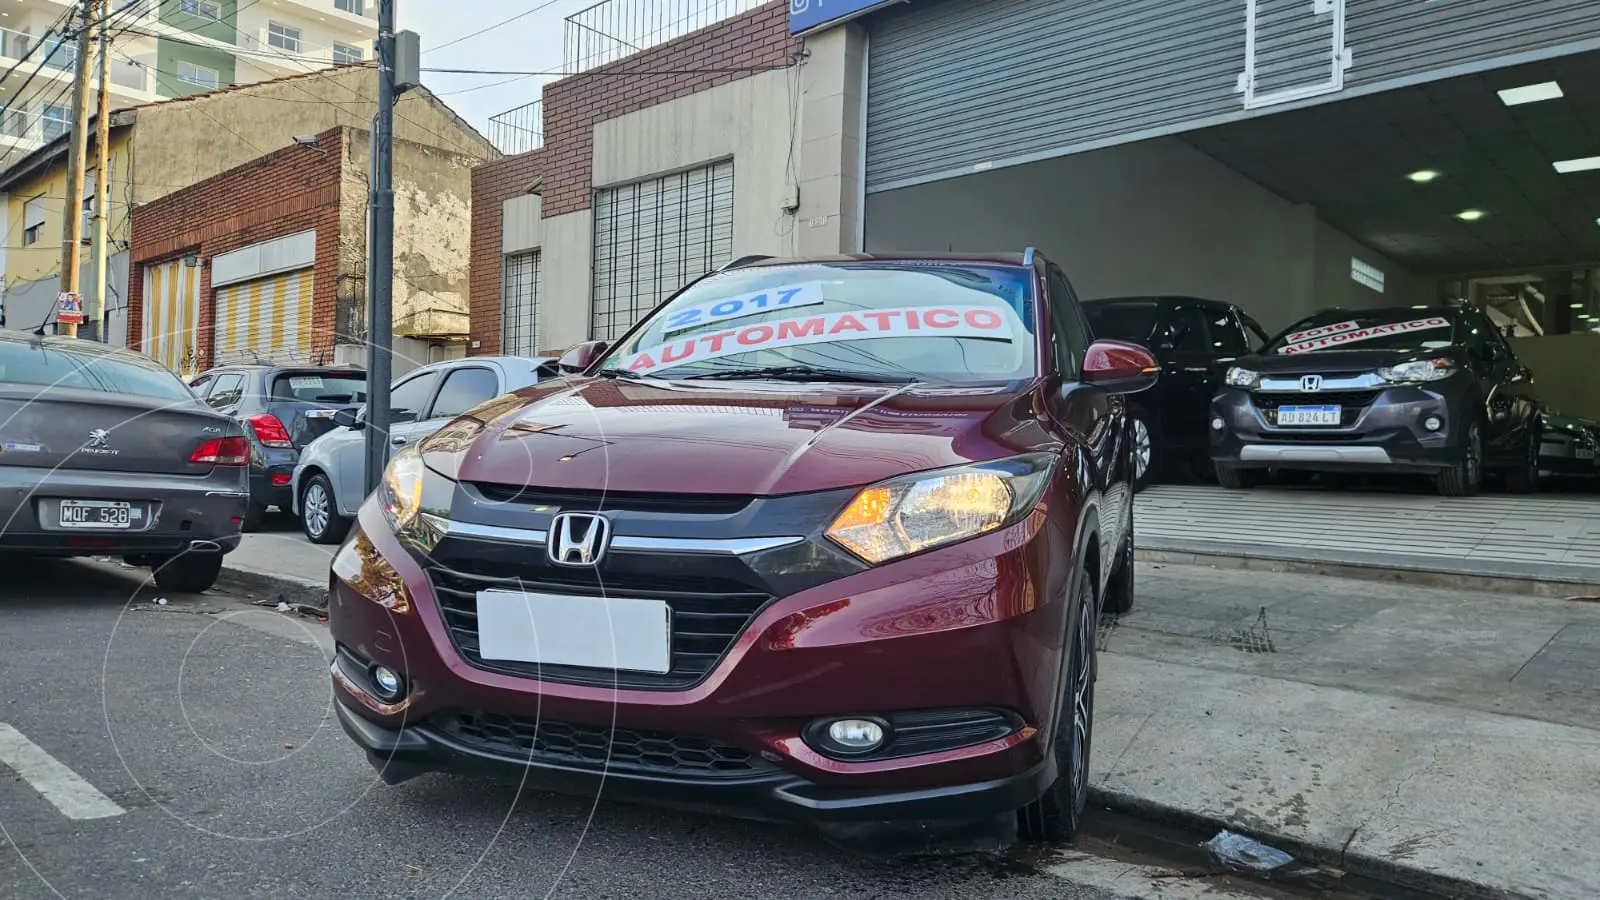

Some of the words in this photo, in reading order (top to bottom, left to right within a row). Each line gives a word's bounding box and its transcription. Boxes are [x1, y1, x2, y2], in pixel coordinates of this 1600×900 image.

[667, 287, 803, 328] 2017
[628, 308, 1002, 372] AUTOMATICO
[1285, 319, 1444, 354] AUTOMATICO
[1290, 323, 1351, 341] 2019
[1281, 413, 1296, 423] AD
[1298, 412, 1319, 423] 824
[63, 507, 91, 522] MQF
[100, 508, 128, 523] 528
